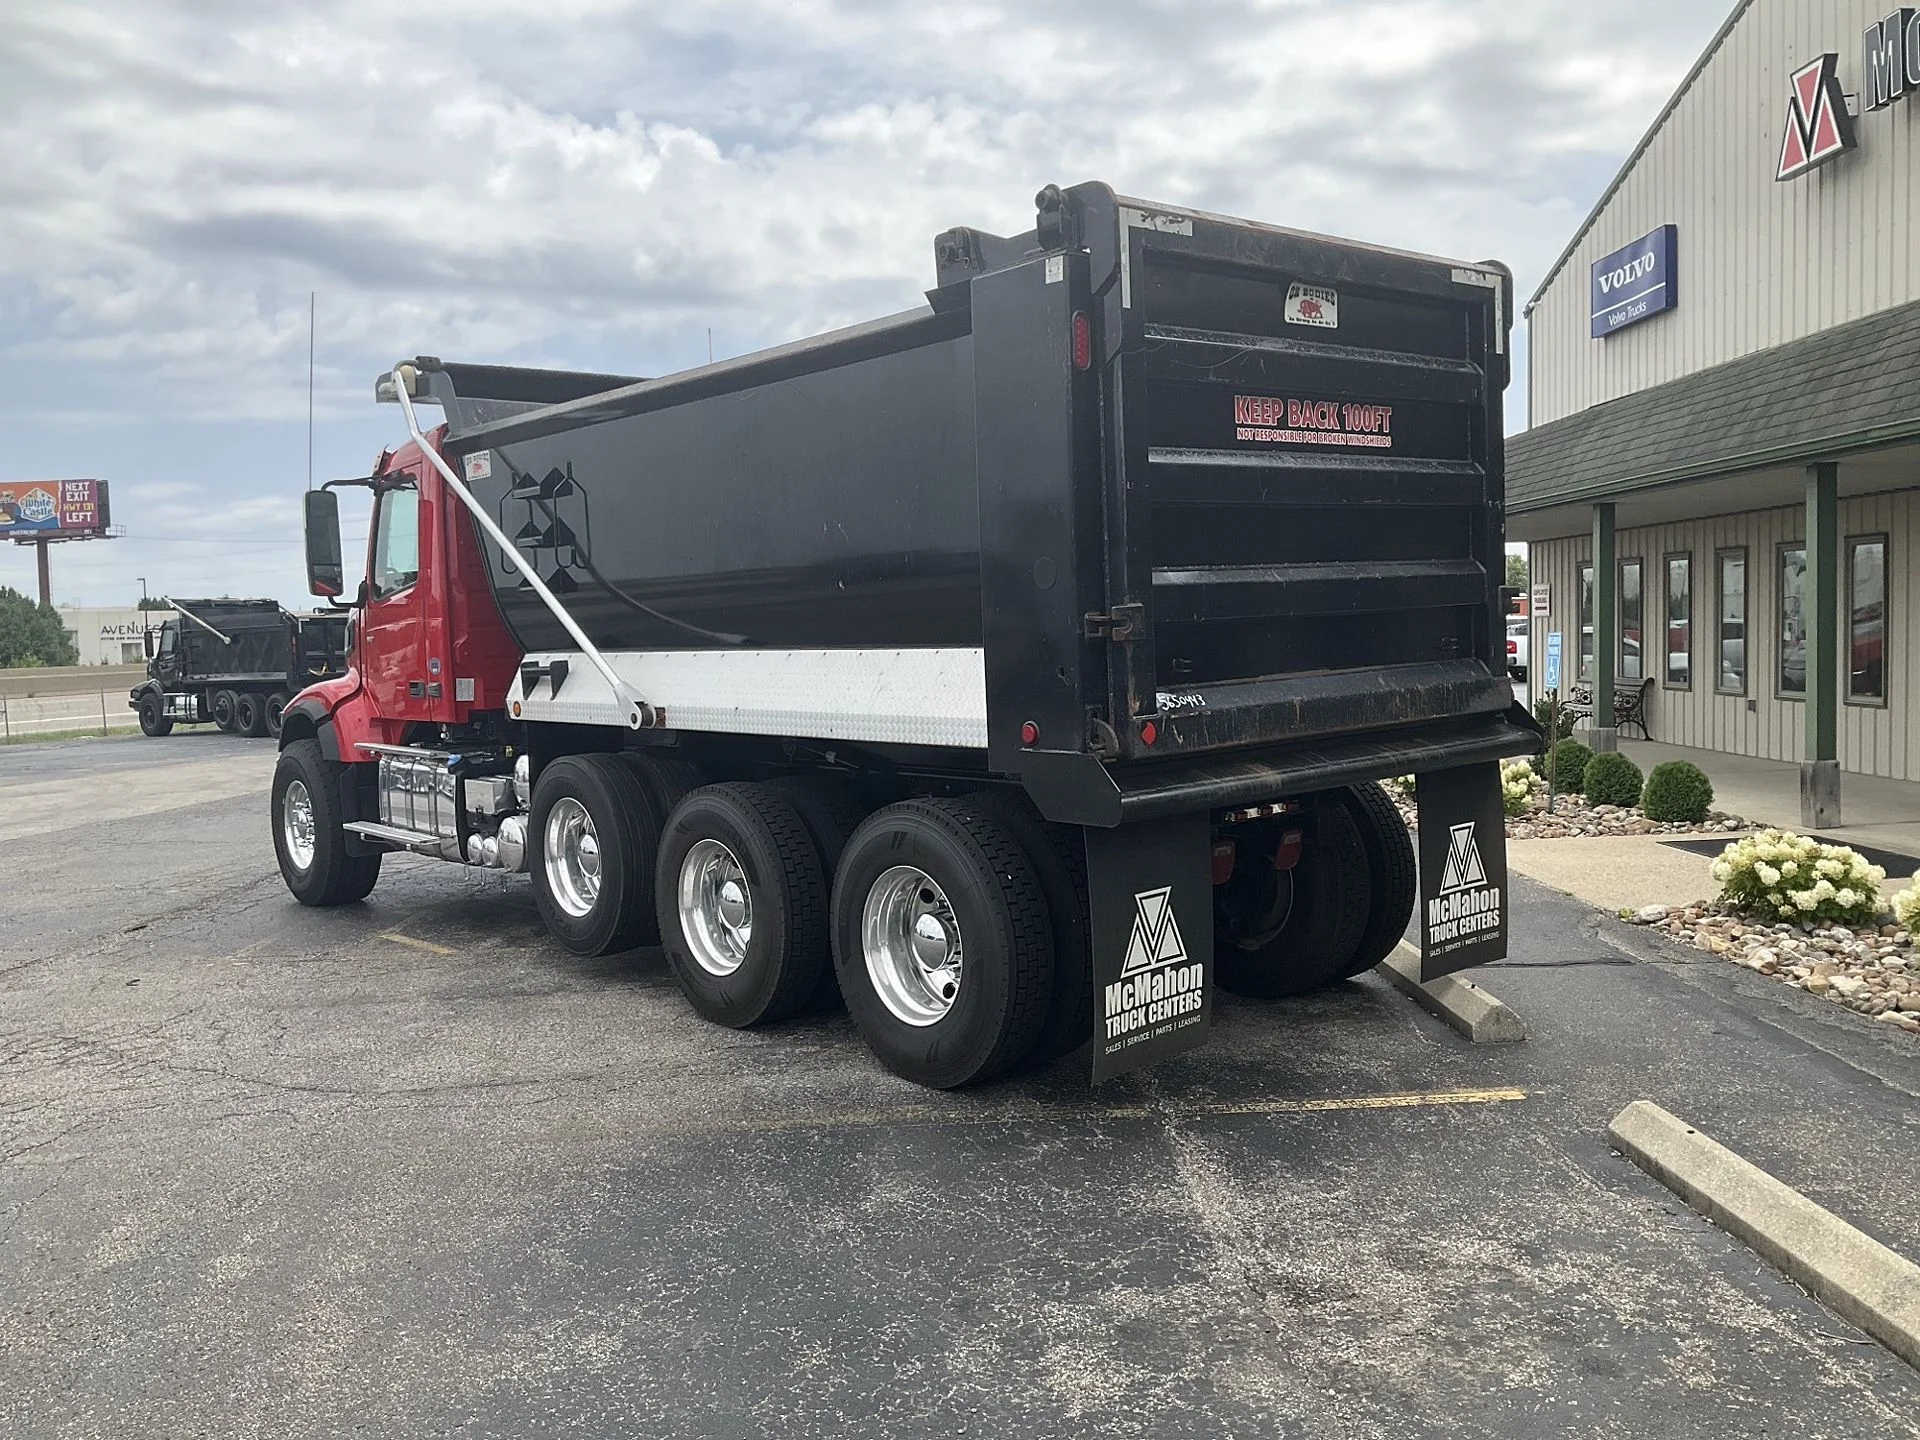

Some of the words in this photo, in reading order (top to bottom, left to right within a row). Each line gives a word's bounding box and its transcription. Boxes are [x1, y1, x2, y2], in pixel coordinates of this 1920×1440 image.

[1598, 251, 1655, 294] VOLVO
[1303, 287, 1335, 306] BODIES
[1608, 311, 1626, 326] Volvo
[1627, 301, 1647, 318] Trucks
[1235, 395, 1283, 426] KEEP
[1288, 399, 1340, 430] BACK
[1343, 403, 1392, 433] 100FT
[1237, 427, 1254, 440] NOT
[1255, 428, 1302, 443] RESPONSIBLE
[1303, 431, 1317, 443] FOR
[1318, 432, 1346, 445] BROKEN
[1347, 434, 1392, 447] WINDSHIELDS
[65, 482, 90, 491] NEXT
[66, 491, 90, 501] EXIT
[23, 507, 53, 516] Castle
[66, 511, 92, 523] LEFT
[1428, 887, 1500, 927] McMahon
[1429, 919, 1458, 945] TRUCK
[1459, 909, 1500, 935] CENTERS
[1105, 962, 1204, 1018] McMahon
[1106, 1008, 1147, 1039] TRUCK
[1148, 989, 1203, 1024] CENTERS
[1105, 1041, 1122, 1055] SALES
[1127, 1031, 1150, 1047] SERVICE
[1155, 1023, 1173, 1036] PARTS
[1178, 1014, 1201, 1029] LEASING
